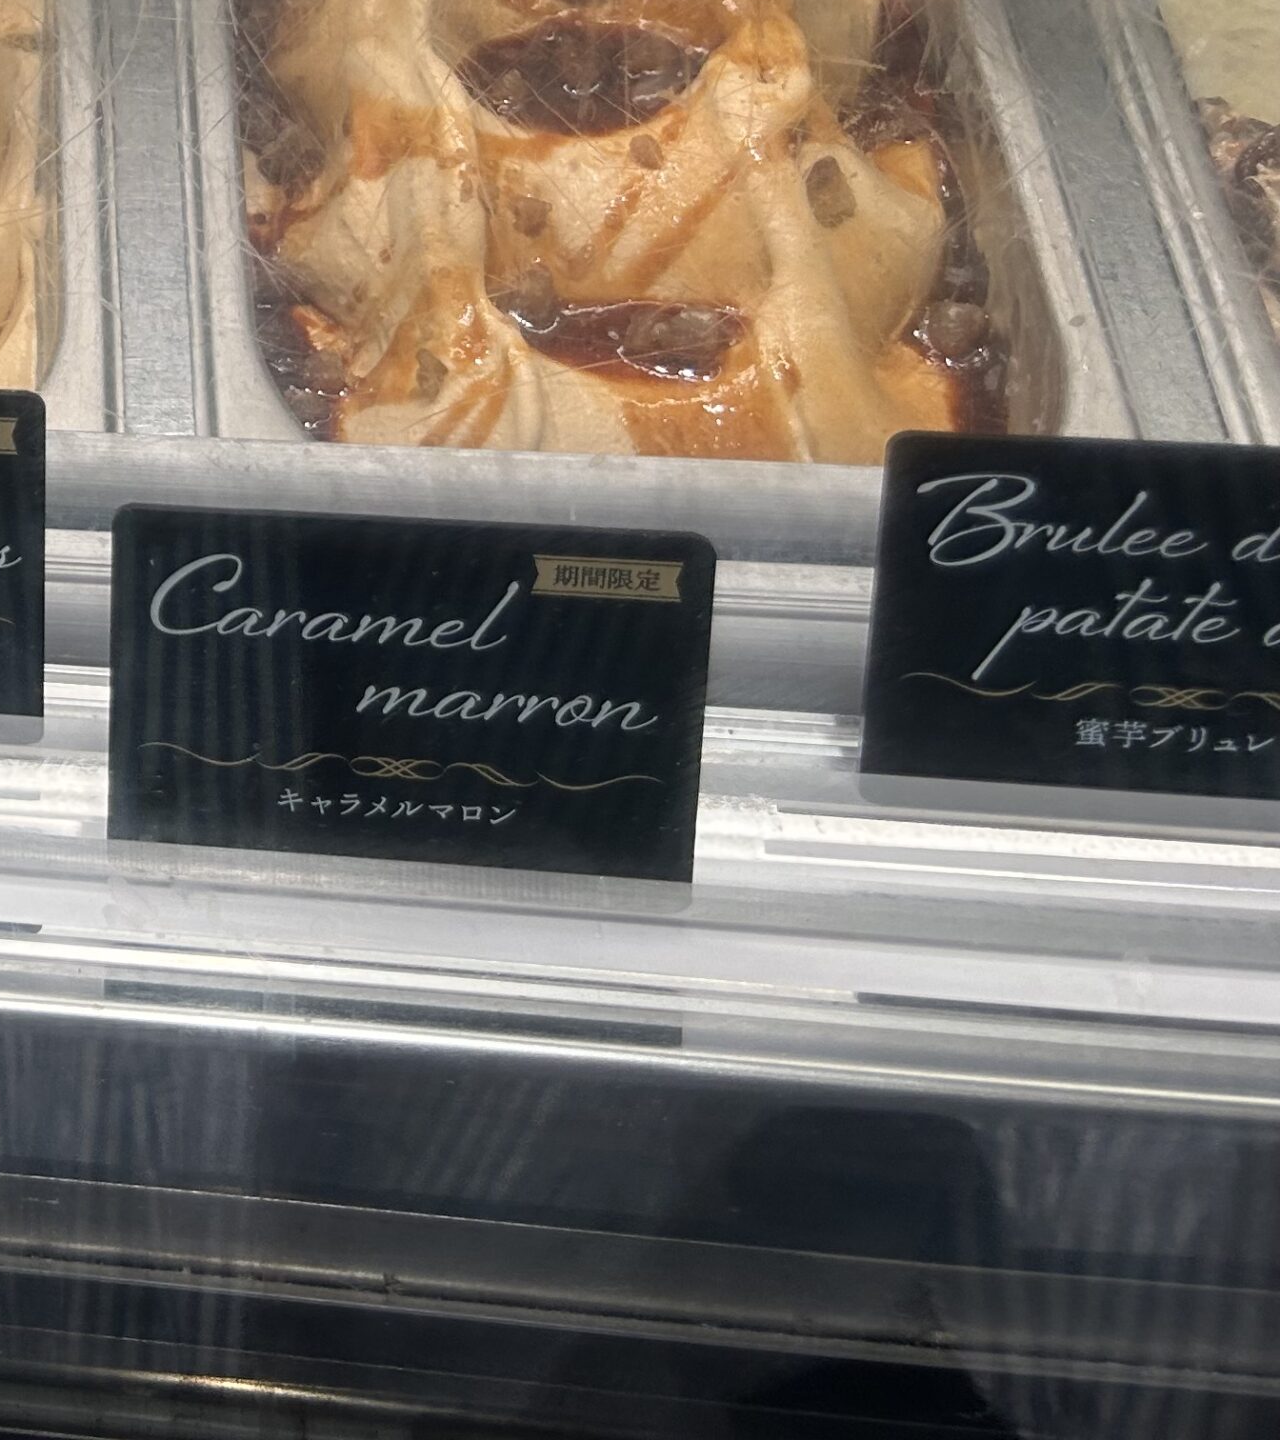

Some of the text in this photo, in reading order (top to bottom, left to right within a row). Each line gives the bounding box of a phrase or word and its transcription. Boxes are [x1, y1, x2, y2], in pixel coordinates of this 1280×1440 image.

[917, 474, 1207, 566] Brulee
[552, 564, 661, 591] 期間限定
[150, 554, 519, 650] Caramel
[972, 578, 1240, 681] patate
[356, 685, 658, 730] marron
[1075, 718, 1276, 752] 蜜芋ブリュレ
[277, 788, 516, 825] キャラメルマロン
